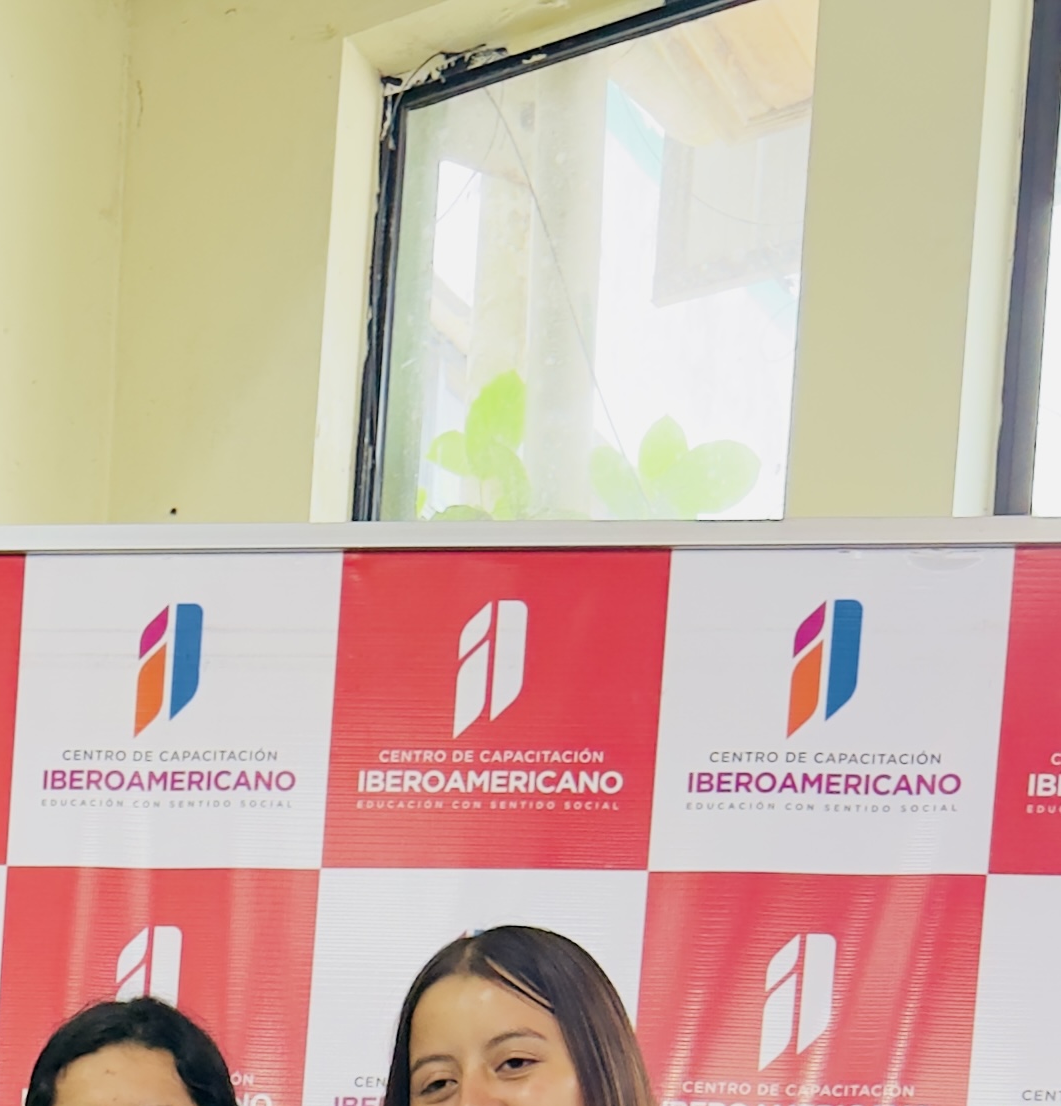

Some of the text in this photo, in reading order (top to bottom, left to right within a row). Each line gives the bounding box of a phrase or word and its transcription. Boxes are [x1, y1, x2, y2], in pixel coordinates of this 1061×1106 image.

[62, 748, 278, 762] CENTRO DE CAPACITACIÓN
[379, 748, 605, 764] CENTRO DE CAPACITACIÓN
[709, 750, 942, 765] CENTRO DE CAPACITACIÓN
[43, 770, 295, 792] IBEROAMERICANO
[357, 770, 624, 794] IBEROAMERICANO
[687, 772, 961, 796] IBEROAMERICANO
[41, 798, 292, 808] EDUCACIÓN CON SENTIDO SOCIAL
[356, 799, 619, 811] EDUCACIÓN CON SENTIDO SOCIAL
[685, 801, 958, 813] EDUCACIÓN CON SENTIDO SOCIAL
[683, 1081, 751, 1095] CENTRO
[757, 1084, 779, 1096] DE
